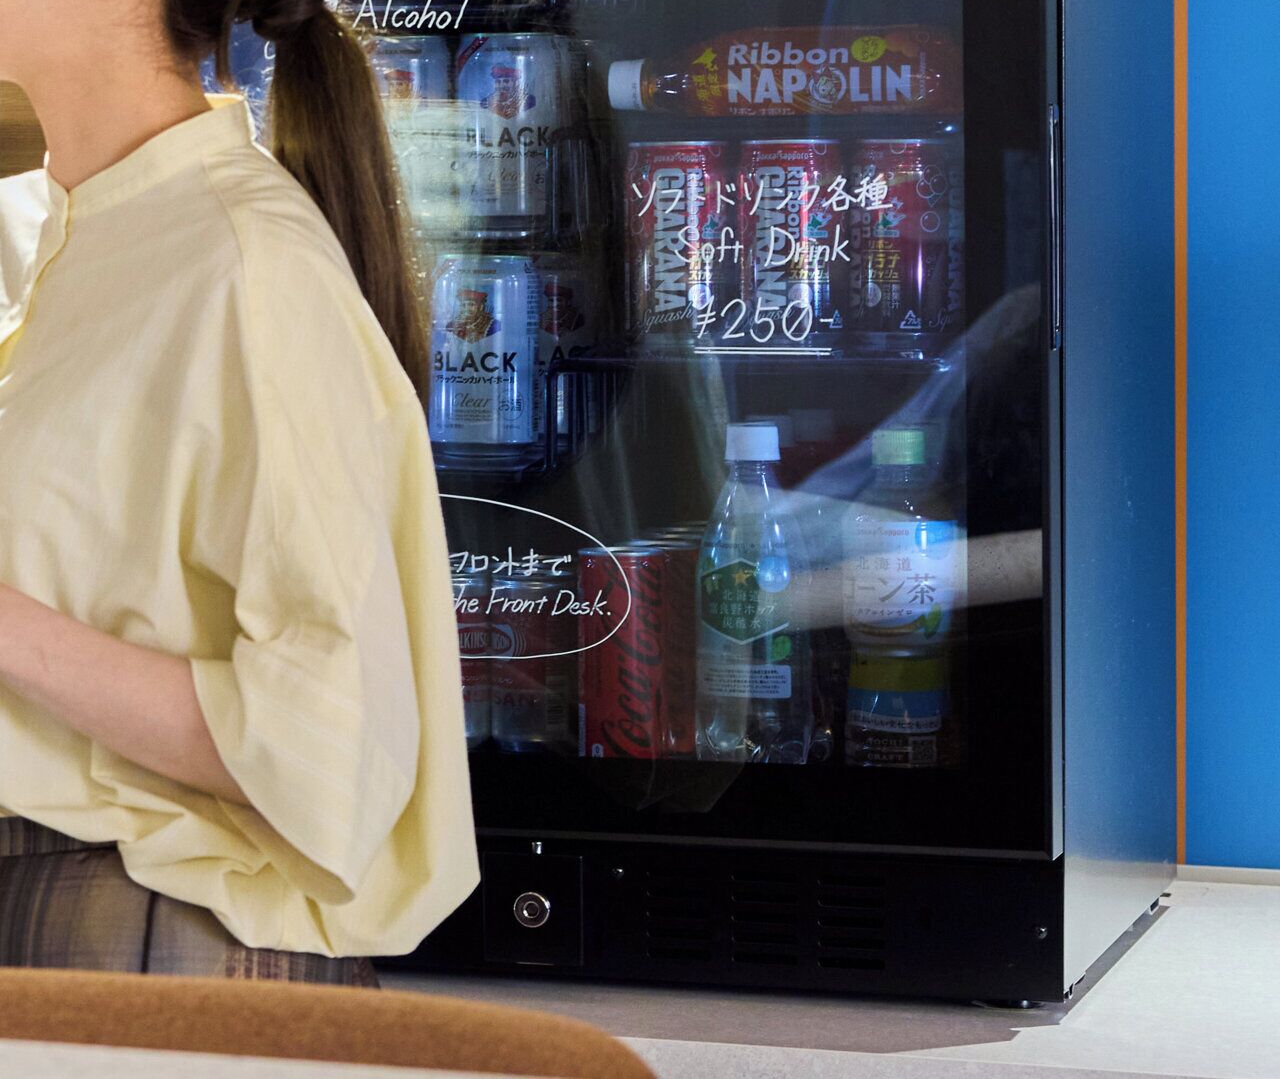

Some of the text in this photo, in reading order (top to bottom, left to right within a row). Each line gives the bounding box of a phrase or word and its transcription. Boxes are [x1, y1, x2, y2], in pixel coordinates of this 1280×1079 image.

[727, 41, 848, 66] Ribbon
[727, 65, 911, 104] NAPOLIN
[631, 175, 893, 217] ソフトドリンク各種
[686, 167, 701, 242] Ribbon
[786, 167, 804, 242] Ribbon
[653, 167, 687, 313] GUARANA
[675, 226, 744, 264] Soft
[763, 225, 851, 267] Drink
[755, 166, 789, 311] GUARANA
[636, 301, 695, 334] Squash
[434, 351, 518, 373] BLACK
[452, 392, 493, 409] Clear
[498, 397, 522, 413] お酒
[448, 546, 572, 576] フロントまで
[855, 556, 913, 572] 北海道
[485, 586, 549, 615] Front
[550, 589, 613, 616] Desk.
[843, 572, 937, 605] コーン茶
[601, 557, 662, 758] Coca-Cola
